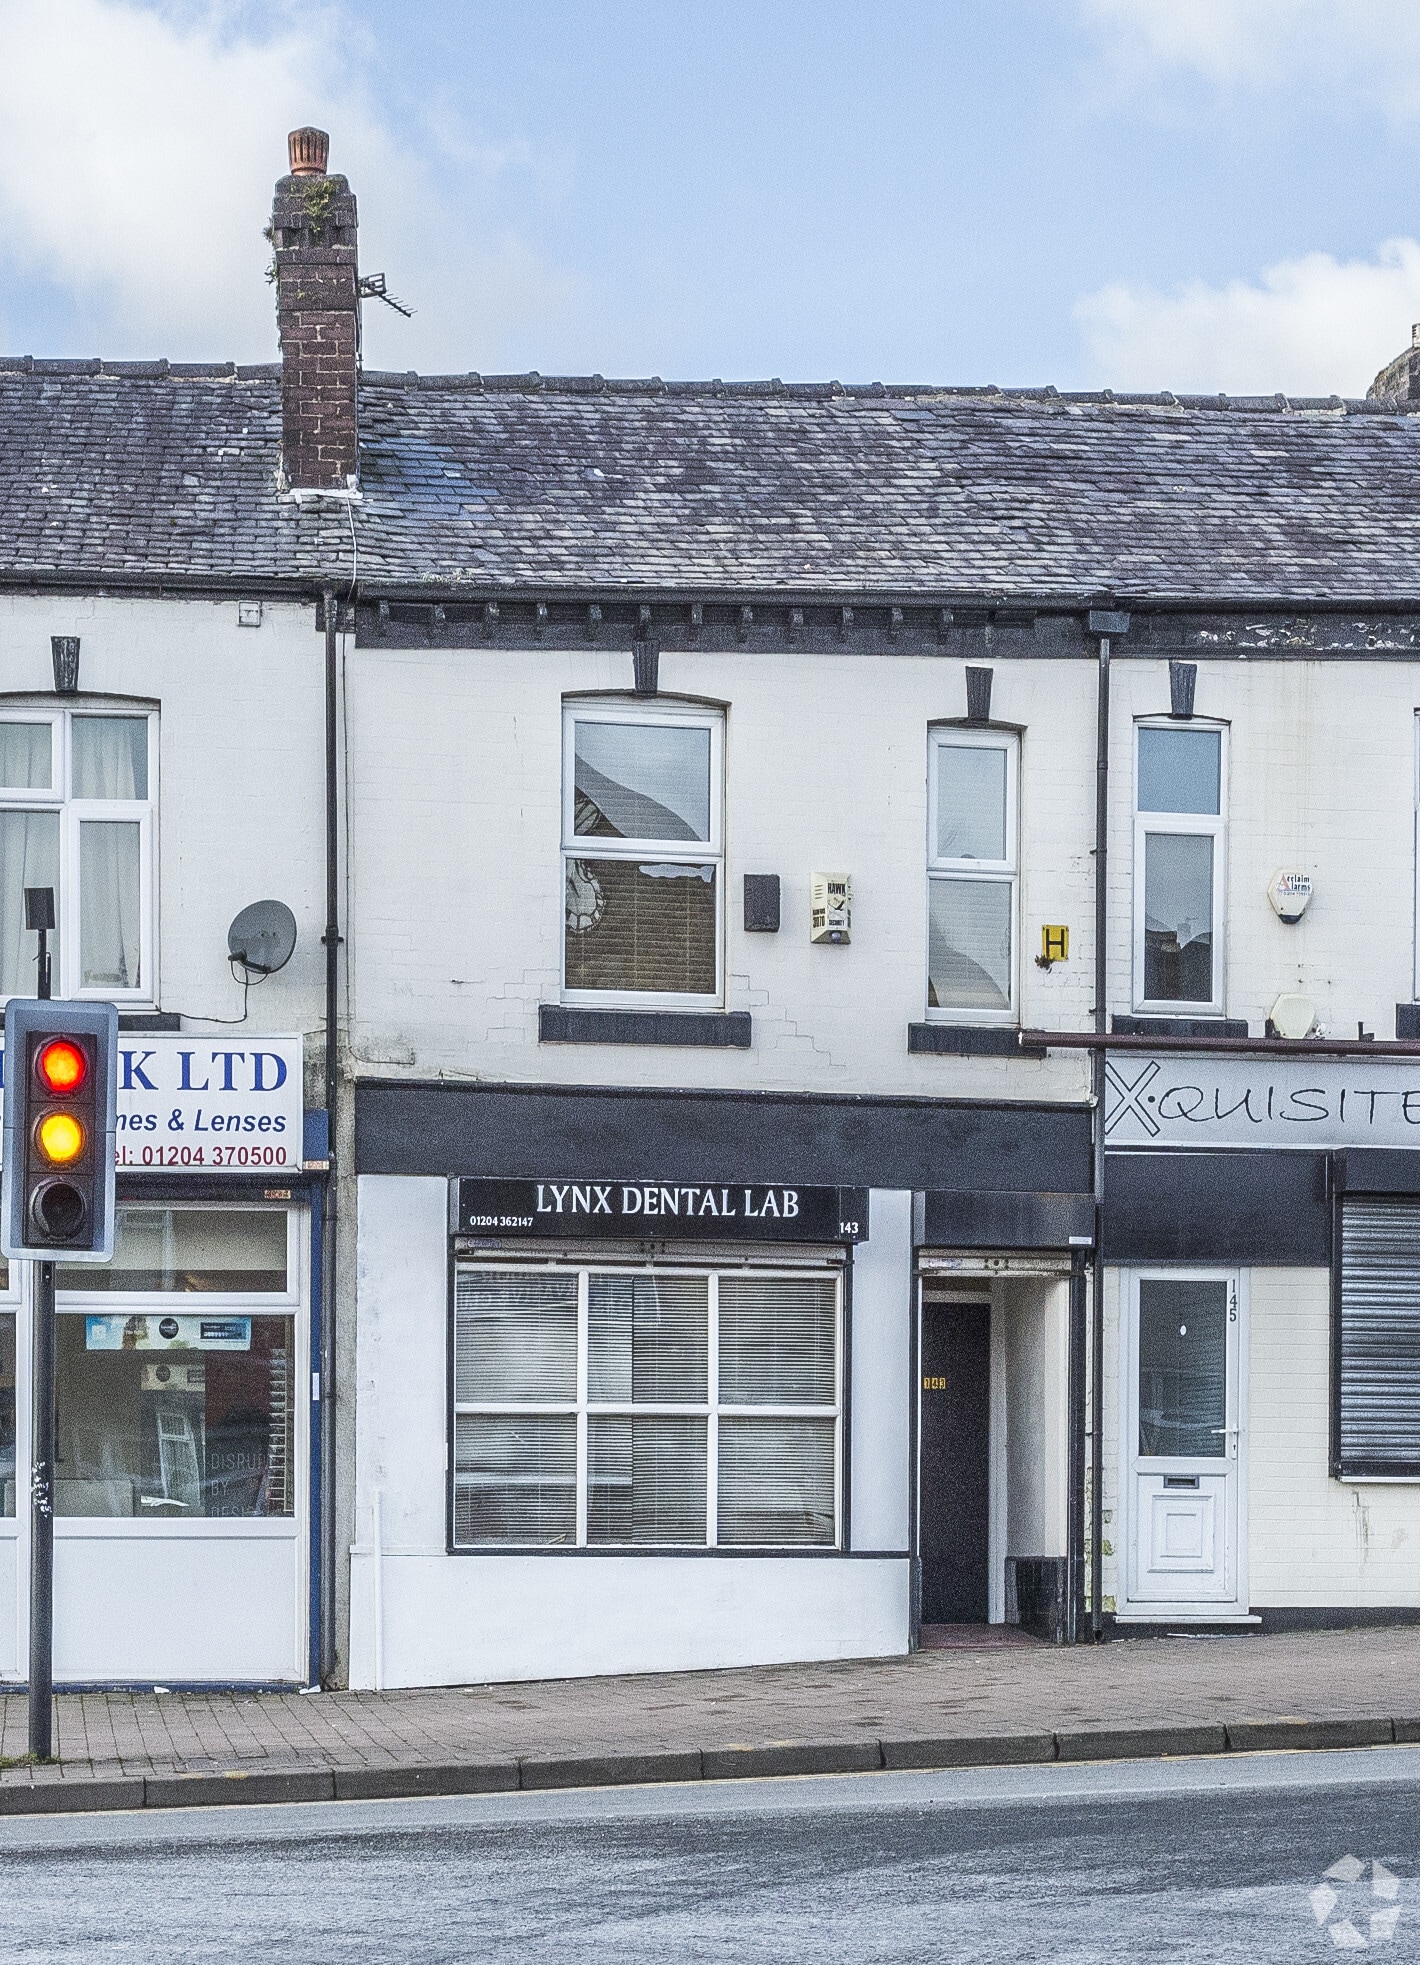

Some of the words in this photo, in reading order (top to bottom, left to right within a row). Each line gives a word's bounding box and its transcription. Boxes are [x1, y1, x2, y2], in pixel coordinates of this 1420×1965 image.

[827, 883, 846, 896] HAWK
[1045, 928, 1065, 958] H
[176, 1052, 288, 1092] LTD
[167, 1108, 185, 1131] &
[194, 1109, 287, 1132] Lenses
[142, 1146, 205, 1166] 01204
[212, 1146, 287, 1166] 370500
[536, 1184, 613, 1213] LYNX
[621, 1187, 736, 1216] DENTAL
[744, 1189, 799, 1218] LAB
[469, 1216, 498, 1227] 01204
[499, 1216, 534, 1228] 362147
[839, 1222, 859, 1234] 143
